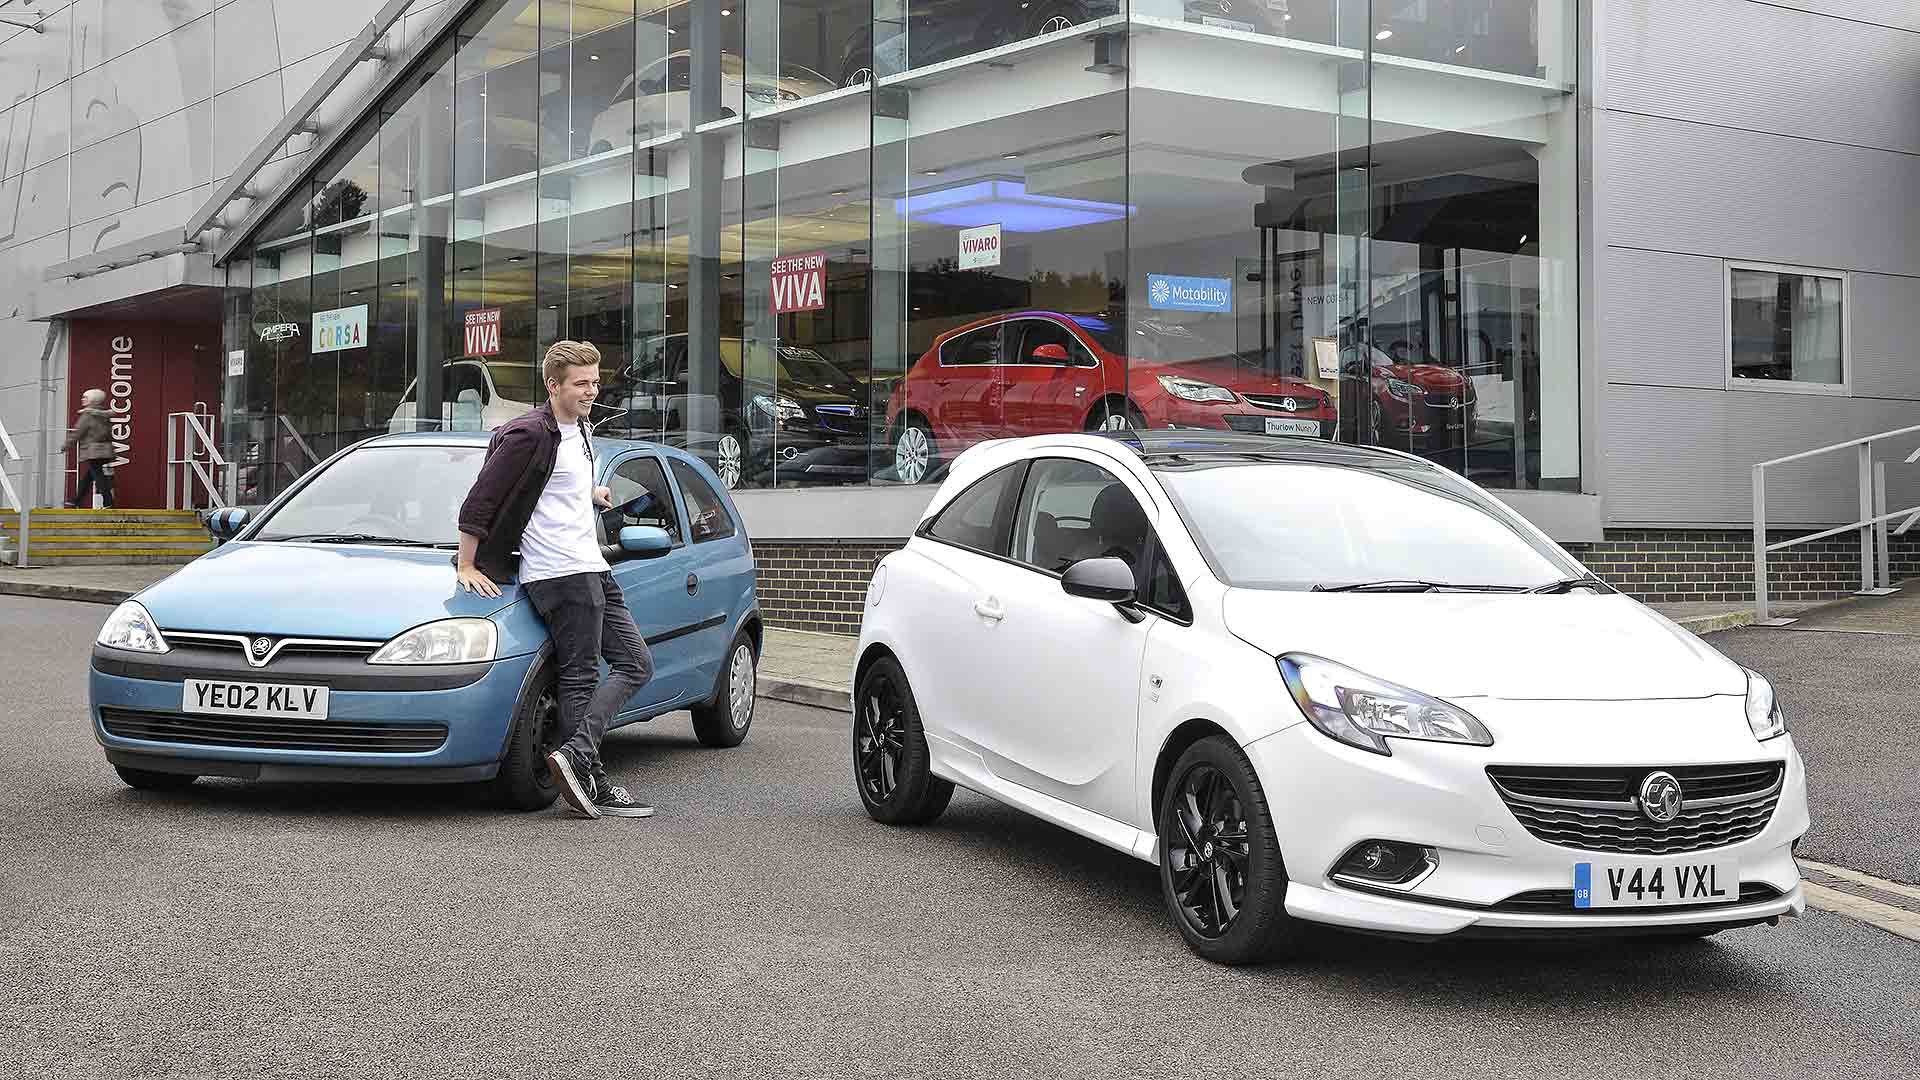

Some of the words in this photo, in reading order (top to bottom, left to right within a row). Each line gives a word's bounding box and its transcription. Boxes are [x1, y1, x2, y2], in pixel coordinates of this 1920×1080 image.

[963, 236, 998, 254] VIVARO
[771, 260, 786, 274] SEE
[787, 258, 803, 272] THE
[804, 255, 824, 269] NEW
[771, 271, 823, 310] VIVA
[1172, 286, 1228, 305] Motability
[1307, 296, 1325, 304] NEW
[465, 313, 476, 324] SEE
[476, 312, 487, 323] THE
[487, 311, 500, 322] NEW
[260, 323, 300, 342] AMPERA
[319, 323, 360, 348] CORSA
[466, 324, 499, 353] VIVA
[110, 336, 133, 468] welcome
[1267, 421, 1294, 431] Thurlow
[195, 683, 260, 710] YE02
[266, 686, 318, 713] KLV
[1607, 867, 1665, 901] V44
[1674, 864, 1726, 899] VXL
[1577, 889, 1589, 899] GB
